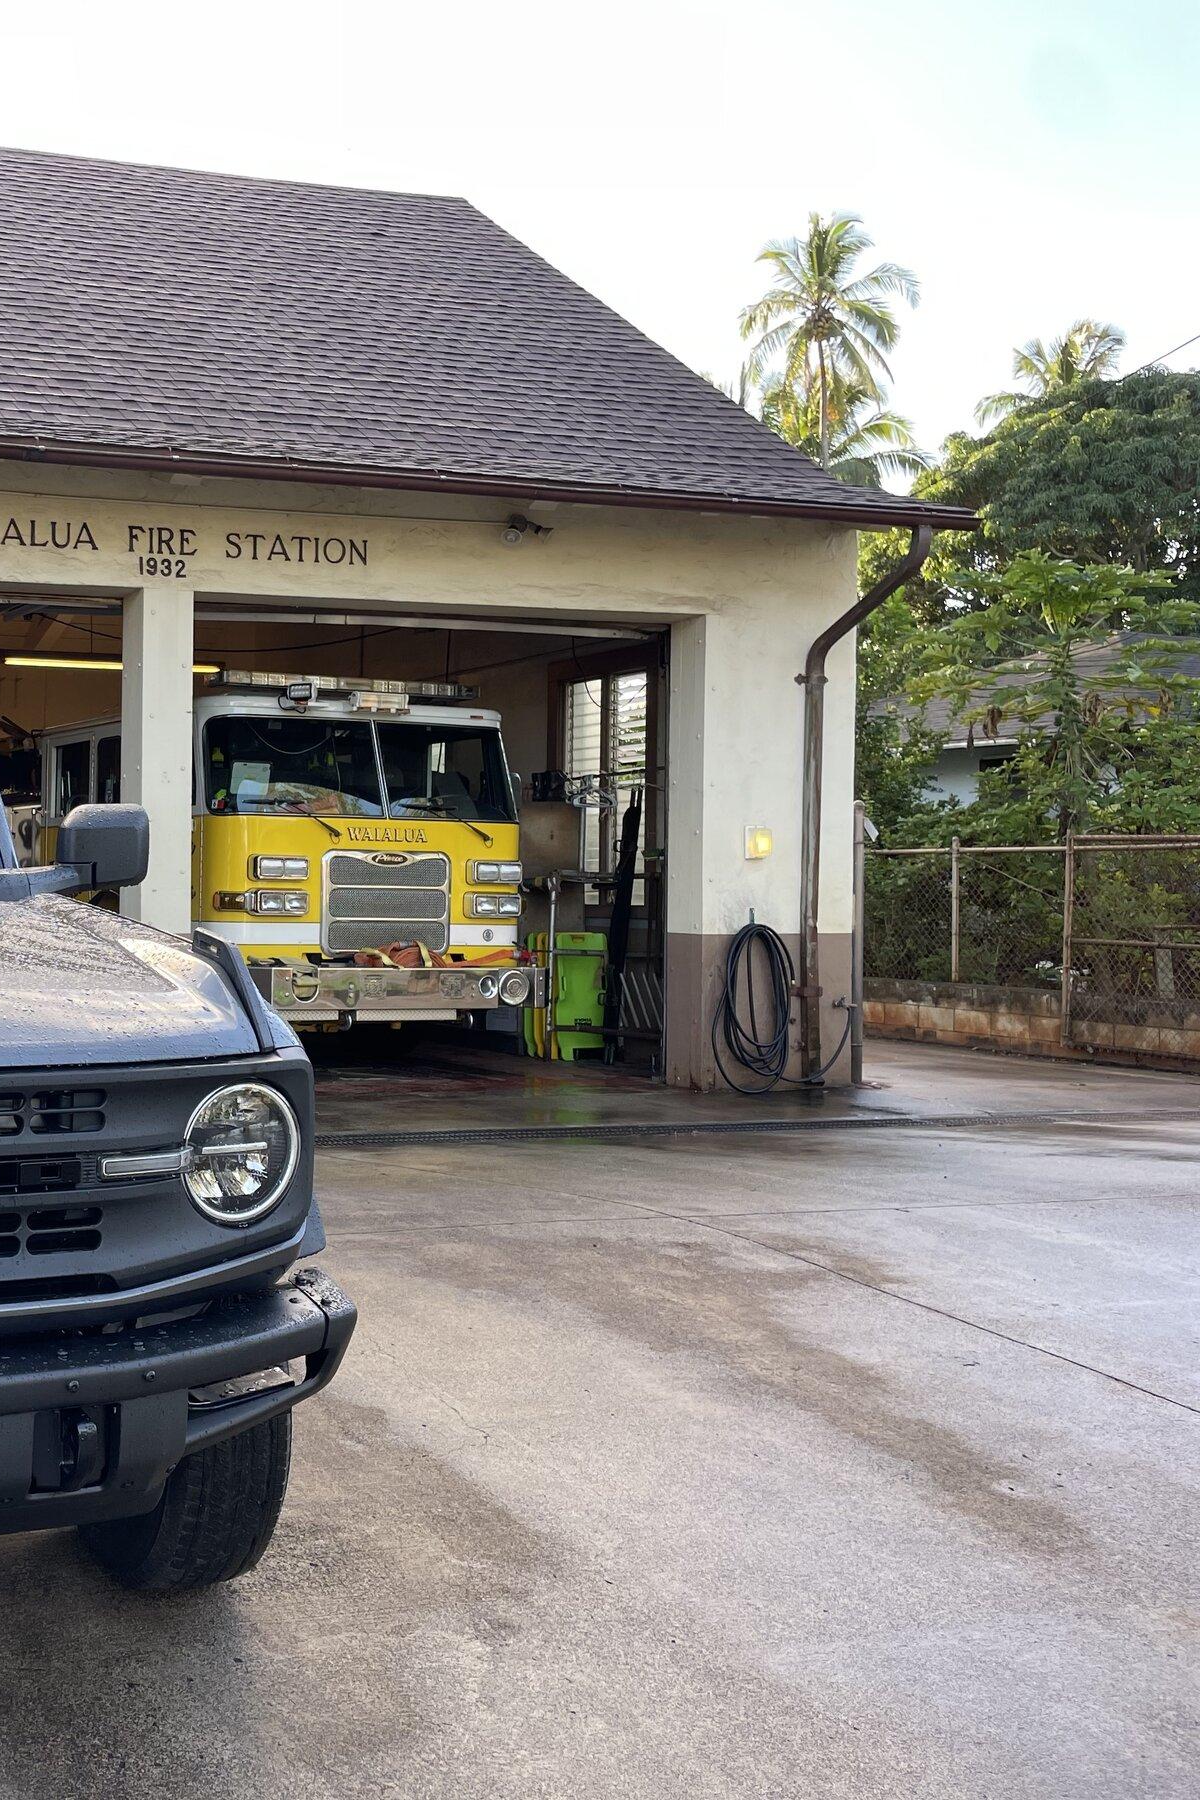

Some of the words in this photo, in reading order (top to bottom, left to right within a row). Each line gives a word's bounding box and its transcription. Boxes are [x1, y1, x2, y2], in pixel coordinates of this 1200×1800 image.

[128, 525, 198, 556] FIRE
[225, 532, 368, 565] STATION
[139, 556, 186, 578] 1932
[347, 826, 428, 843] WAIALUA
